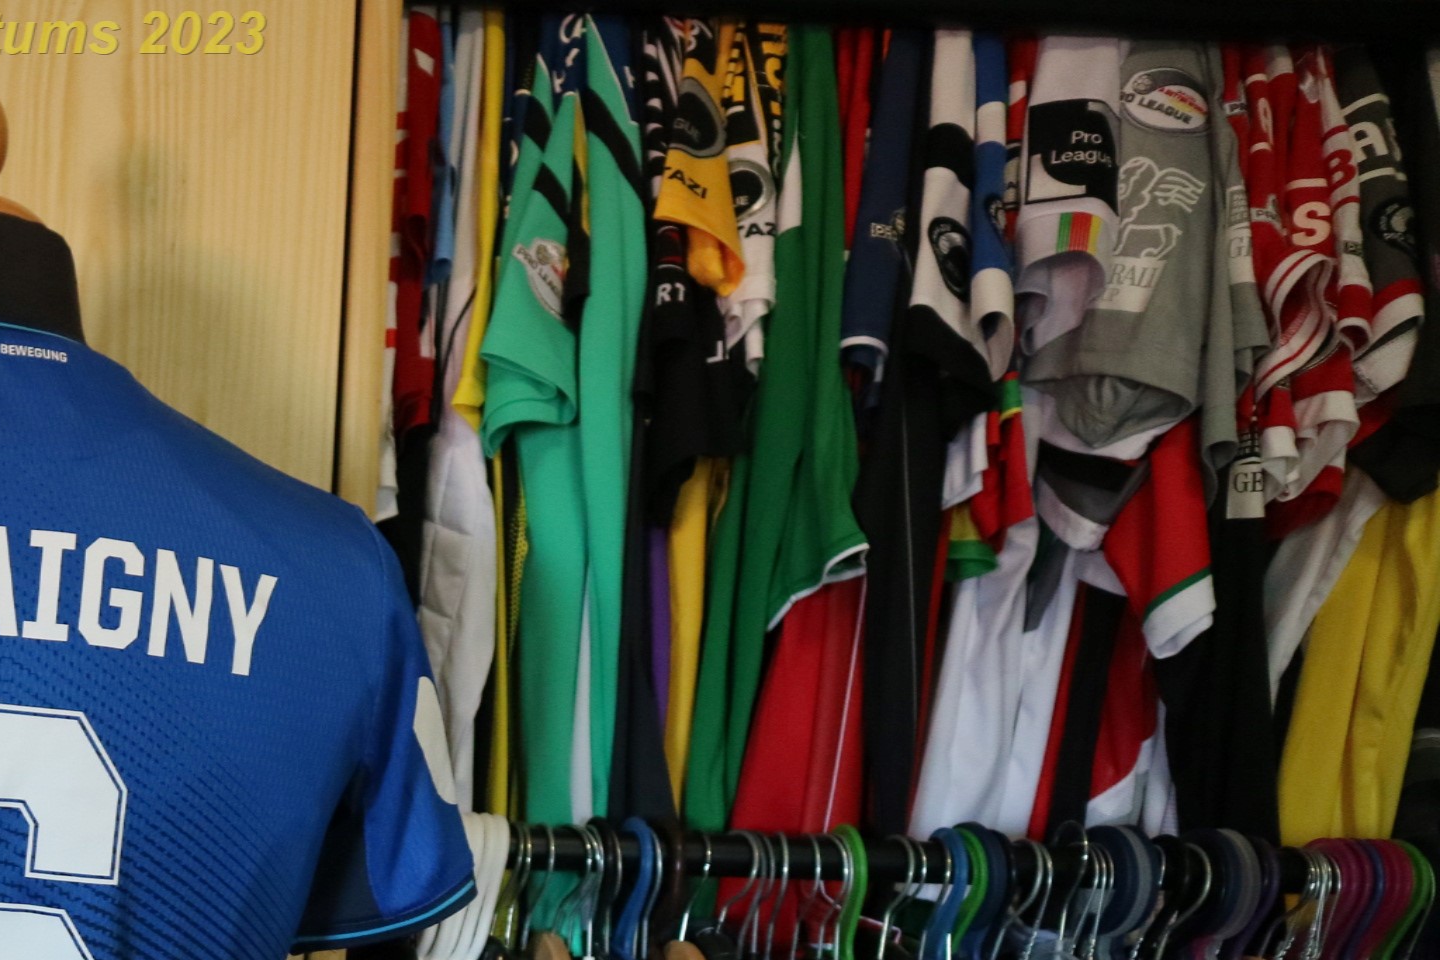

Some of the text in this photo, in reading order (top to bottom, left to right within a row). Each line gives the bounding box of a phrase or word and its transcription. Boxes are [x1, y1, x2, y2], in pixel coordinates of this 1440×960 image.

[1137, 97, 1192, 125] LEAGUE
[1071, 130, 1103, 145] Pro
[0, 343, 69, 364] BEWEGUNG
